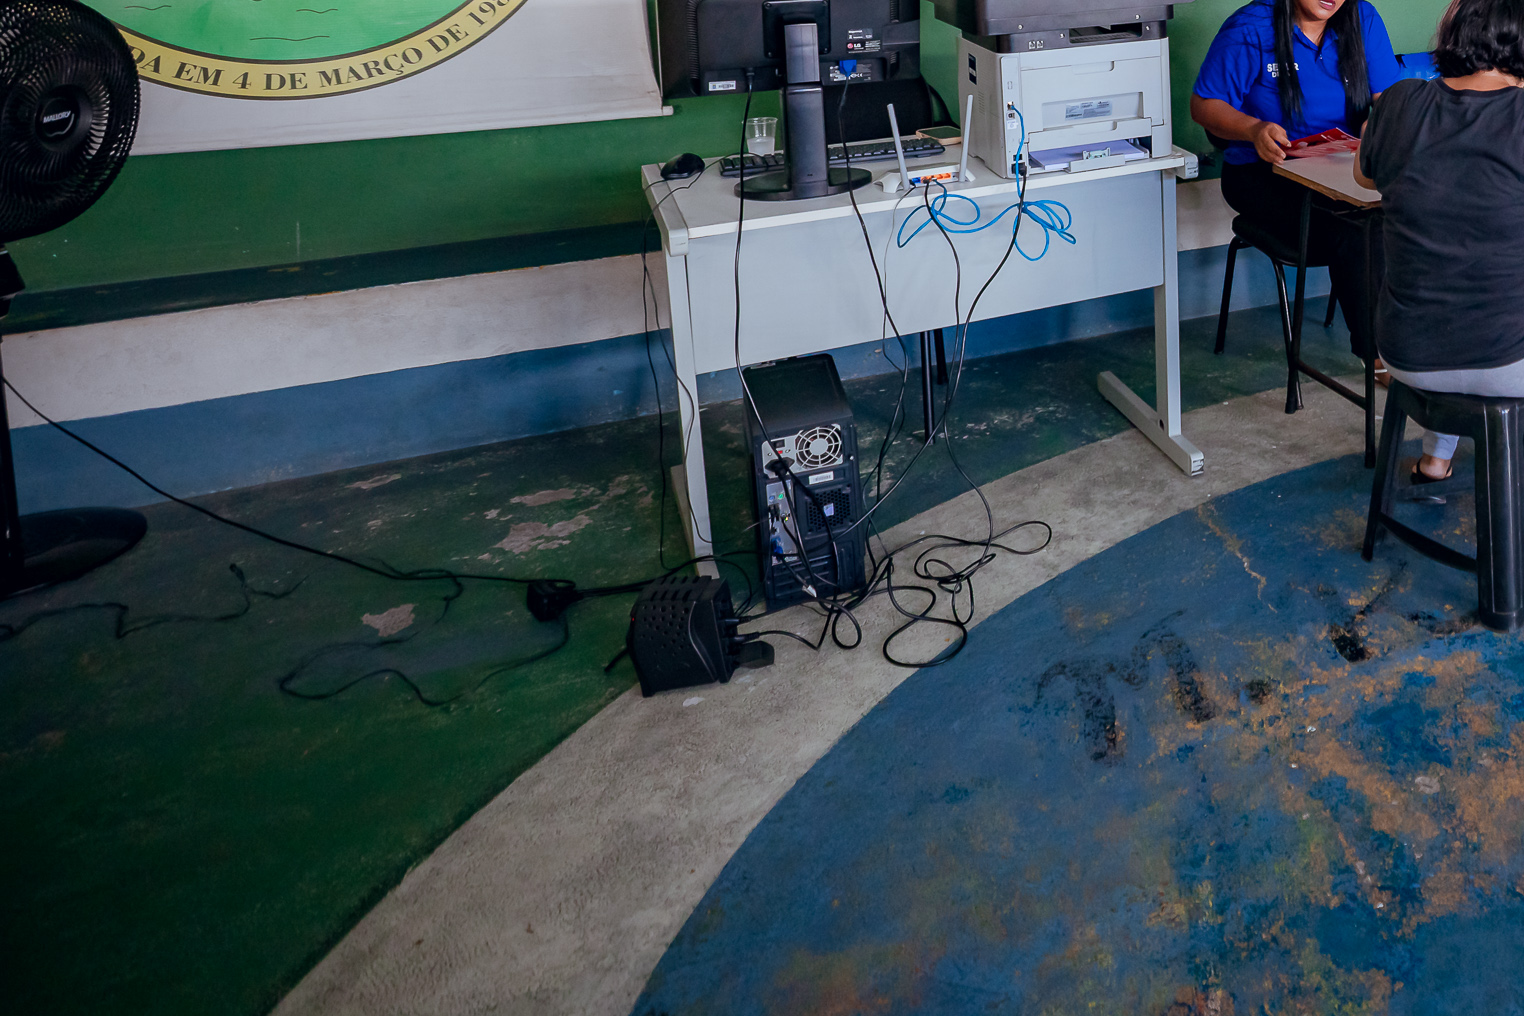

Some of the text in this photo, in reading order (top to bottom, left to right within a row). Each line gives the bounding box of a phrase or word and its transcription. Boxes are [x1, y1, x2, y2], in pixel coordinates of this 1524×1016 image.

[172, 61, 225, 88] EM
[231, 70, 252, 91] 4
[263, 72, 308, 92] DE
[319, 46, 423, 89] MARÇO
[425, 22, 469, 55] DE
[43, 110, 71, 124] MALLORY
